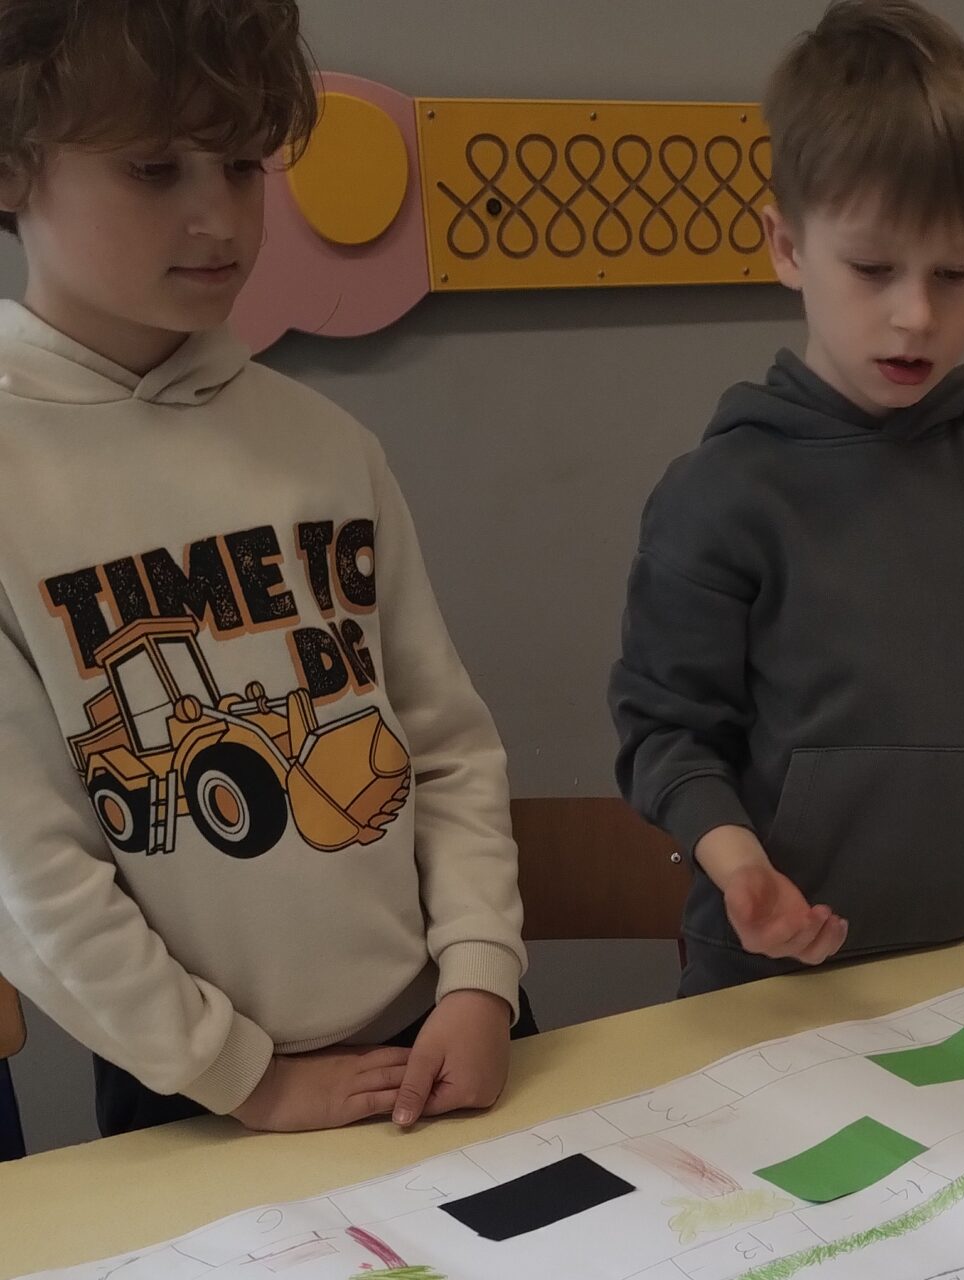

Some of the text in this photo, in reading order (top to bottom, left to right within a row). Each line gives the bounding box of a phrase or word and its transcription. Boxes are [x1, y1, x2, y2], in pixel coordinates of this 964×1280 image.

[40, 519, 377, 676] TIME TO
[532, 1132, 565, 1154] 4
[734, 1231, 774, 1260] 13
